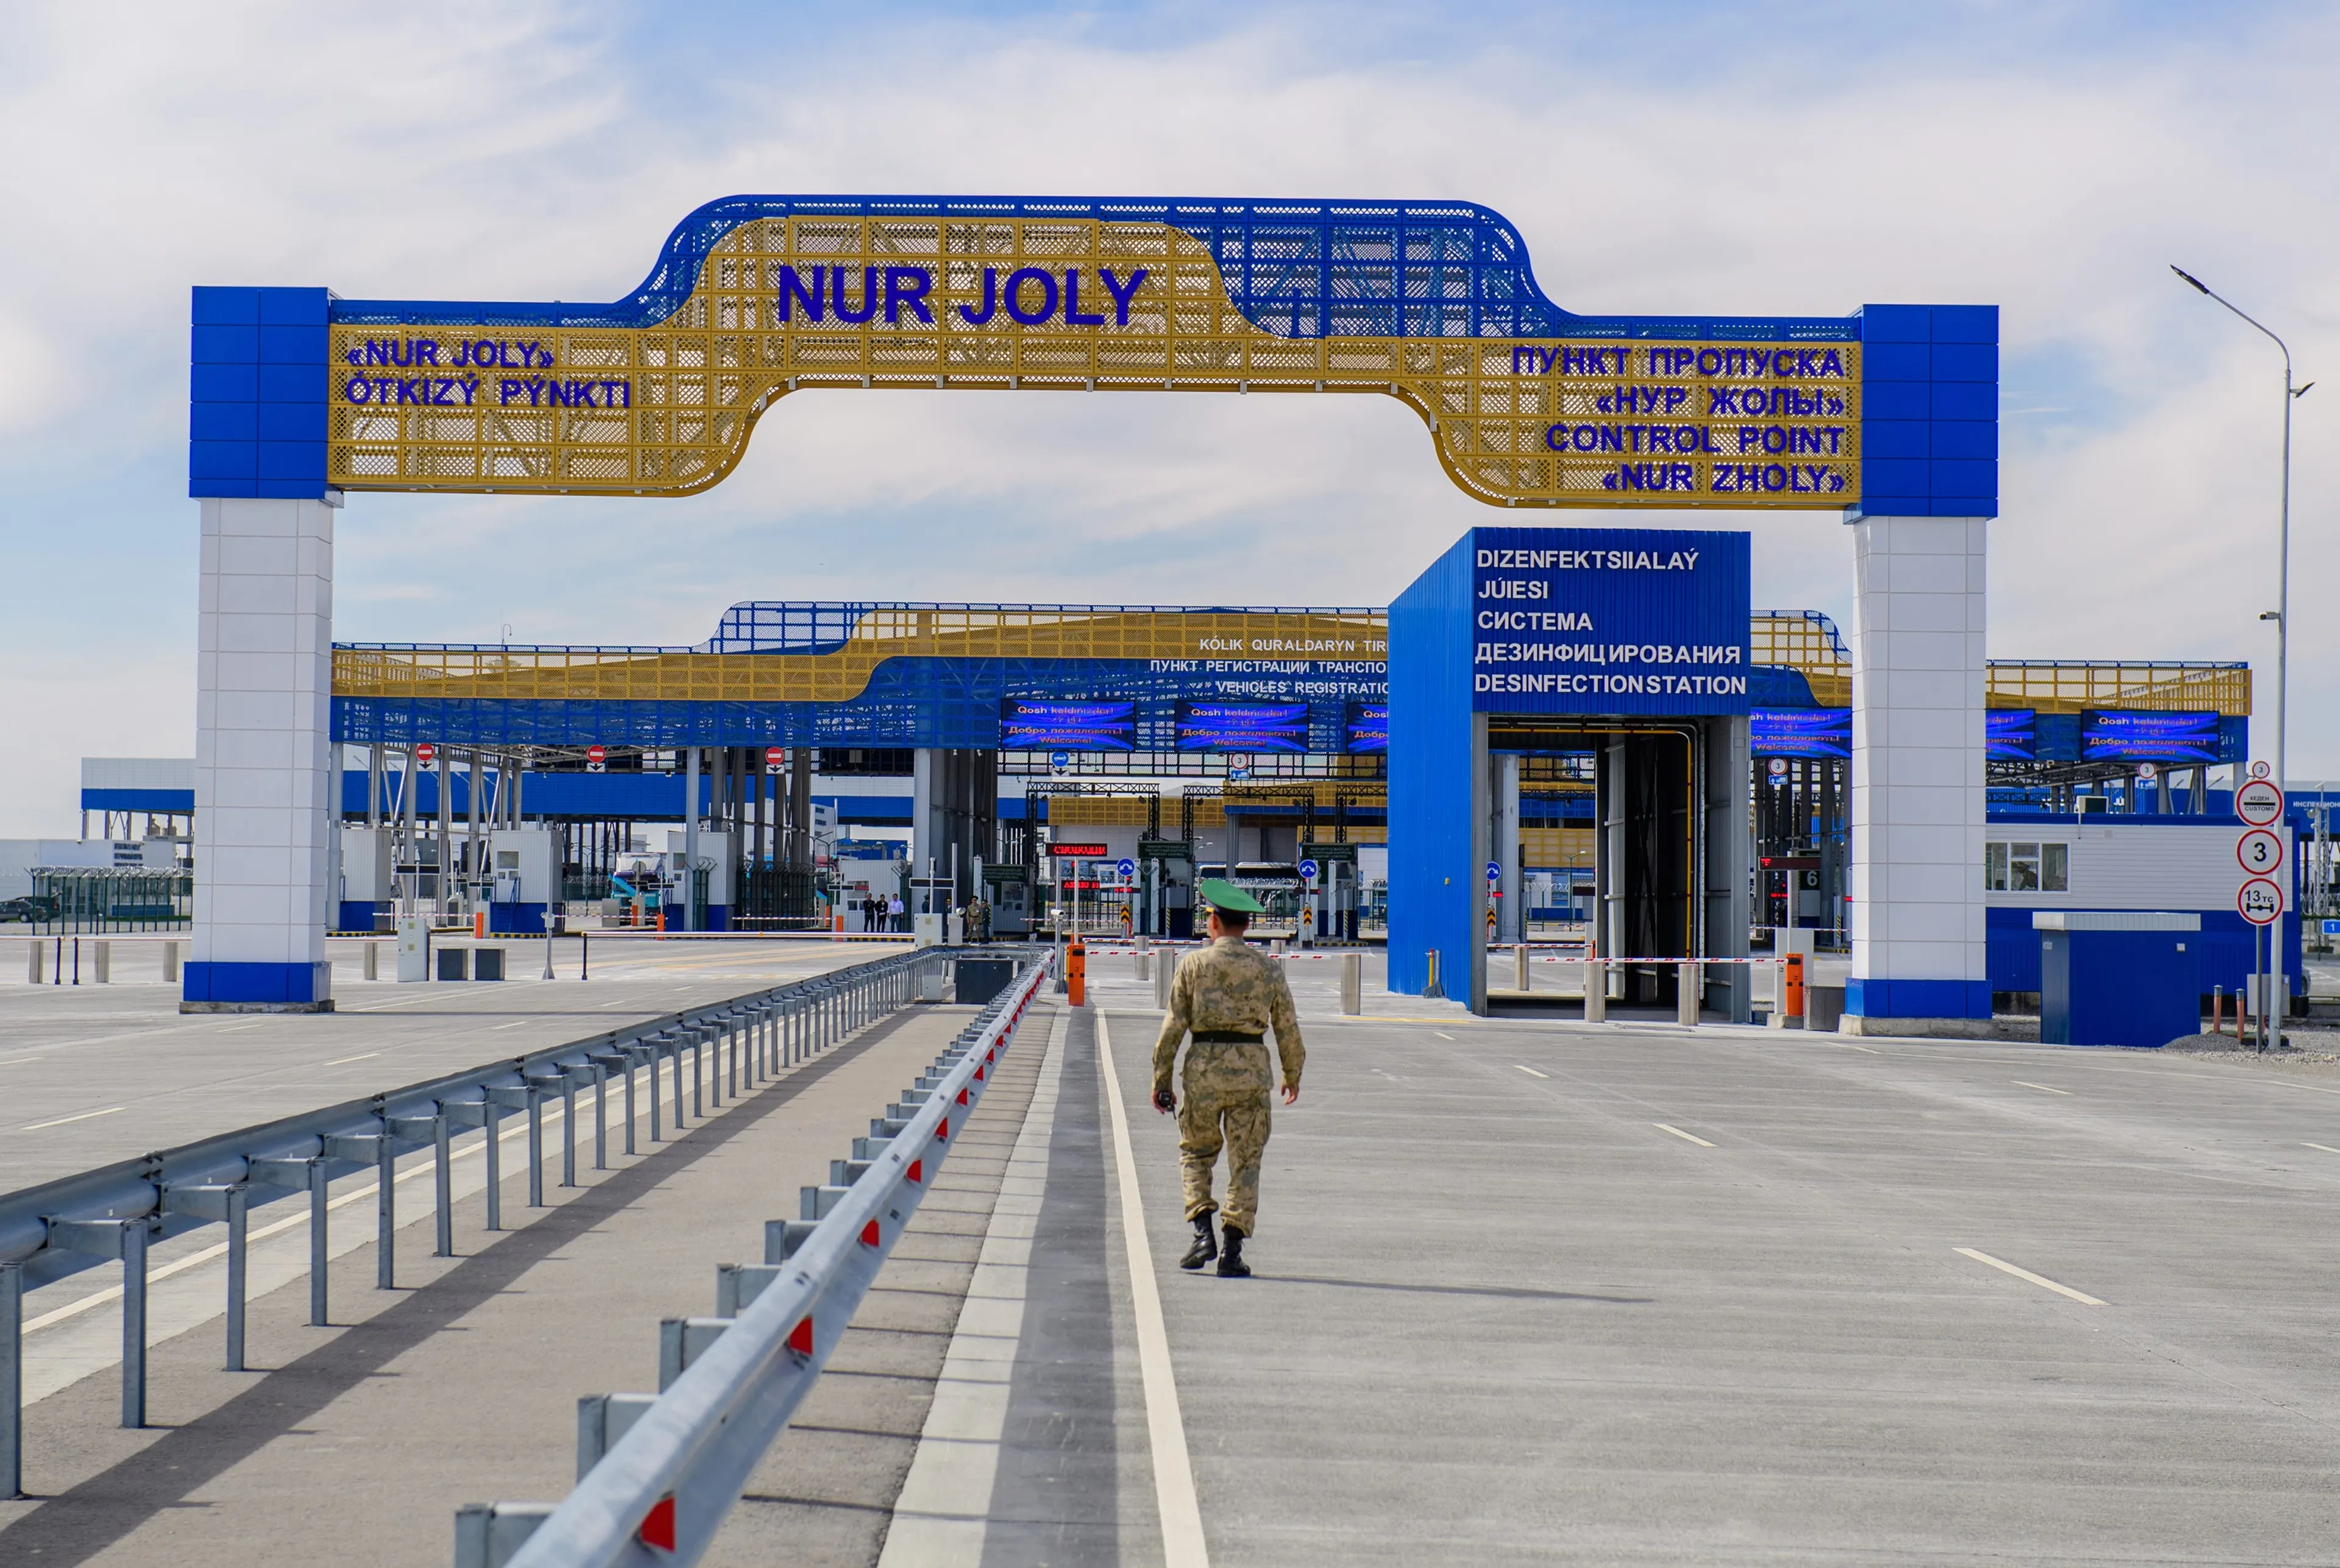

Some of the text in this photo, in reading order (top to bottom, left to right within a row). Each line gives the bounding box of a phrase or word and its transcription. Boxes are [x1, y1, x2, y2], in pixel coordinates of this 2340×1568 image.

[779, 266, 1148, 325] NUR JOLY
[347, 339, 553, 367] «NUR JOLY»
[1513, 347, 1844, 376] ПУНКТ ПРОПУСКА
[346, 371, 630, 407] ÓTKIZÝ PÝNKTI
[1597, 386, 1844, 415] «НУР ЖОЛЫ»
[1547, 424, 1845, 453] CONTROL POINT
[1603, 464, 1845, 492] «NUR ZHOLY»
[1477, 548, 1699, 570] DIZENFEKTSIIALAÝ
[1478, 577, 1548, 599] JÚIESI
[1478, 611, 1594, 631] СИСТЕМА
[1199, 636, 1388, 651] KÓLIK QURALDARYN TIR
[1475, 643, 1741, 665] ДЕЗИНФИЦИРОВАНИЯ
[1150, 660, 1387, 674] ПУНКТ РЕГИСТРАЦИИ ТРАНСПО
[1217, 681, 1388, 694] VEHICLES REGISTRATIO
[1017, 706, 1047, 714] Qosh
[1191, 708, 1221, 717] Qosh
[2090, 737, 2128, 746] Добро
[2253, 842, 2267, 862] 3
[1807, 870, 1818, 886] 6
[2330, 923, 2335, 932] 1
